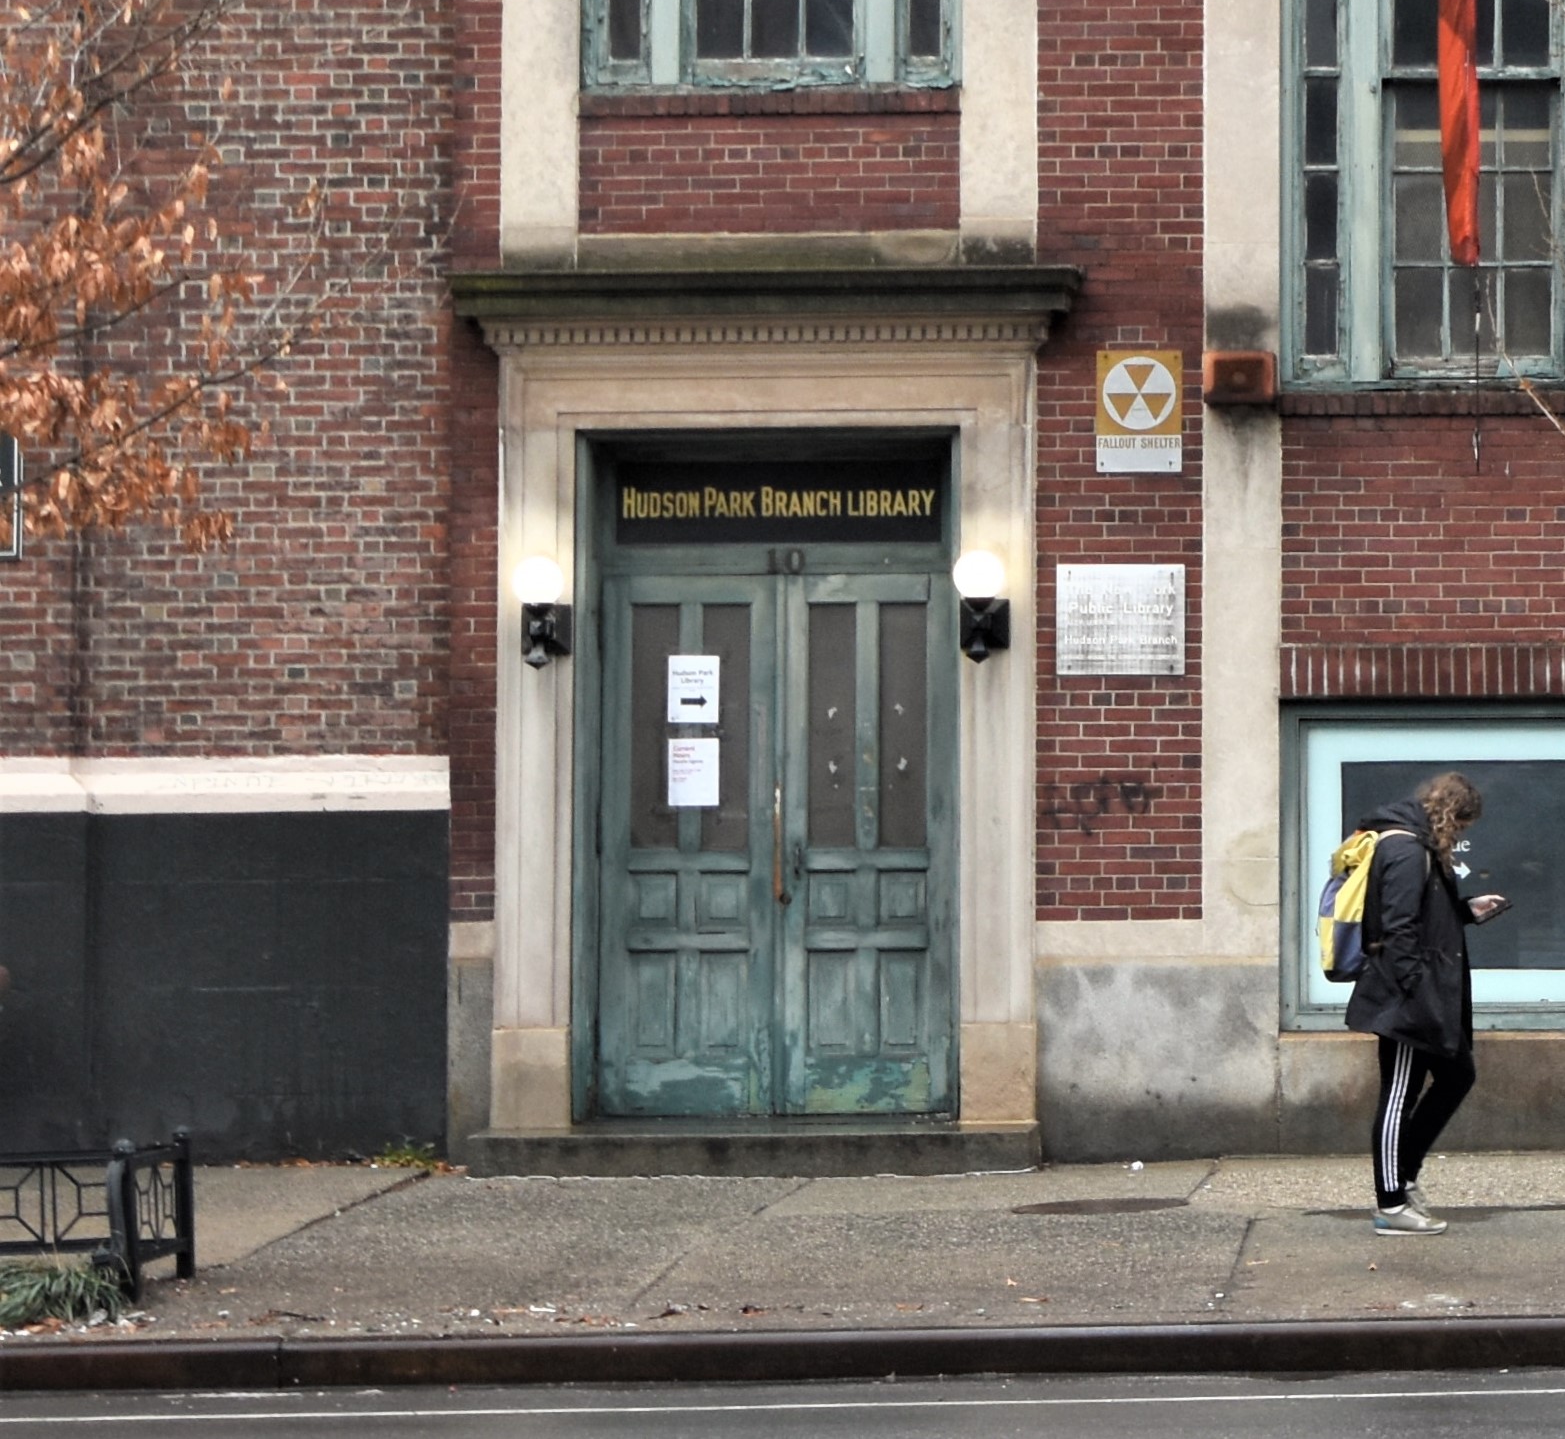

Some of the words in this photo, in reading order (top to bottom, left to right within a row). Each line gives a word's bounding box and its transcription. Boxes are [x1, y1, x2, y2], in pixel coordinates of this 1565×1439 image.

[1098, 438, 1136, 449] FALLOUT
[1141, 437, 1181, 449] SHELTER
[622, 487, 700, 518] HUDSON
[704, 486, 756, 517] PARK
[761, 486, 841, 517] BRANCH
[848, 489, 936, 517] LIBRARY
[767, 547, 806, 575] 10
[1069, 602, 1113, 614] Public
[1123, 602, 1174, 617] Library
[1064, 634, 1106, 645] Hudson
[1110, 634, 1135, 645] Park
[1139, 634, 1178, 645] Branch
